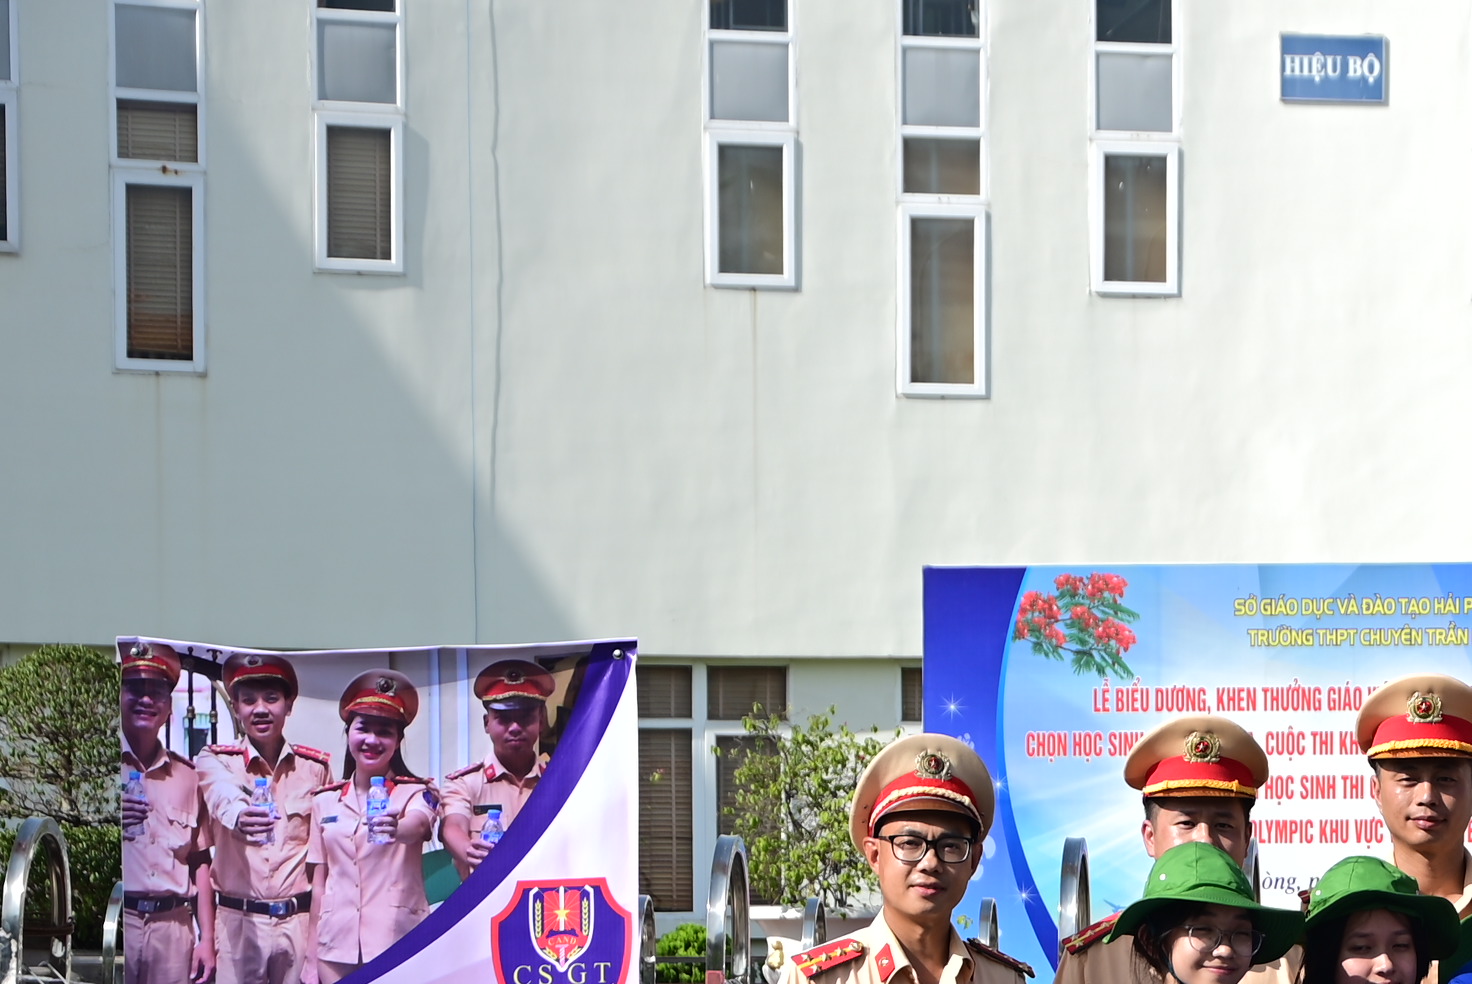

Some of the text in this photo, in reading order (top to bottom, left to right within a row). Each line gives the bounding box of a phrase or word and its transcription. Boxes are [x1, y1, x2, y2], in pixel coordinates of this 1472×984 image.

[1283, 51, 1380, 86] HIỆU BỘ
[1234, 594, 1258, 616] SỞ
[1260, 594, 1299, 616] GIÁO
[1301, 597, 1334, 619] DỤC
[1337, 594, 1359, 615] VÀ
[1361, 593, 1396, 615] ĐÀO
[1398, 597, 1430, 618] TẠO
[1433, 592, 1460, 615] HẢI
[1247, 625, 1314, 646] TRƯỜNG
[1317, 628, 1357, 646] THPT
[1360, 624, 1422, 646] CHUYÊN
[1426, 621, 1469, 646] TRẦN
[1093, 677, 1110, 712] LỄ
[1115, 677, 1150, 712] BIỂU
[1155, 685, 1211, 714] DƯƠNG,
[1216, 687, 1257, 711] KHEN
[1261, 678, 1325, 711] THƯỞNG
[1327, 681, 1362, 711] GIÁO
[1026, 731, 1068, 762] CHỌN
[1072, 731, 1104, 762] HỌC
[1108, 731, 1144, 756] SIN
[1266, 726, 1305, 761] CUỘC
[1311, 731, 1337, 755] THI
[1265, 775, 1294, 805] HỌC
[1300, 775, 1337, 799] SINH
[1341, 775, 1365, 799] THI
[1319, 819, 1350, 843] KHU
[1355, 817, 1385, 849] VỰC
